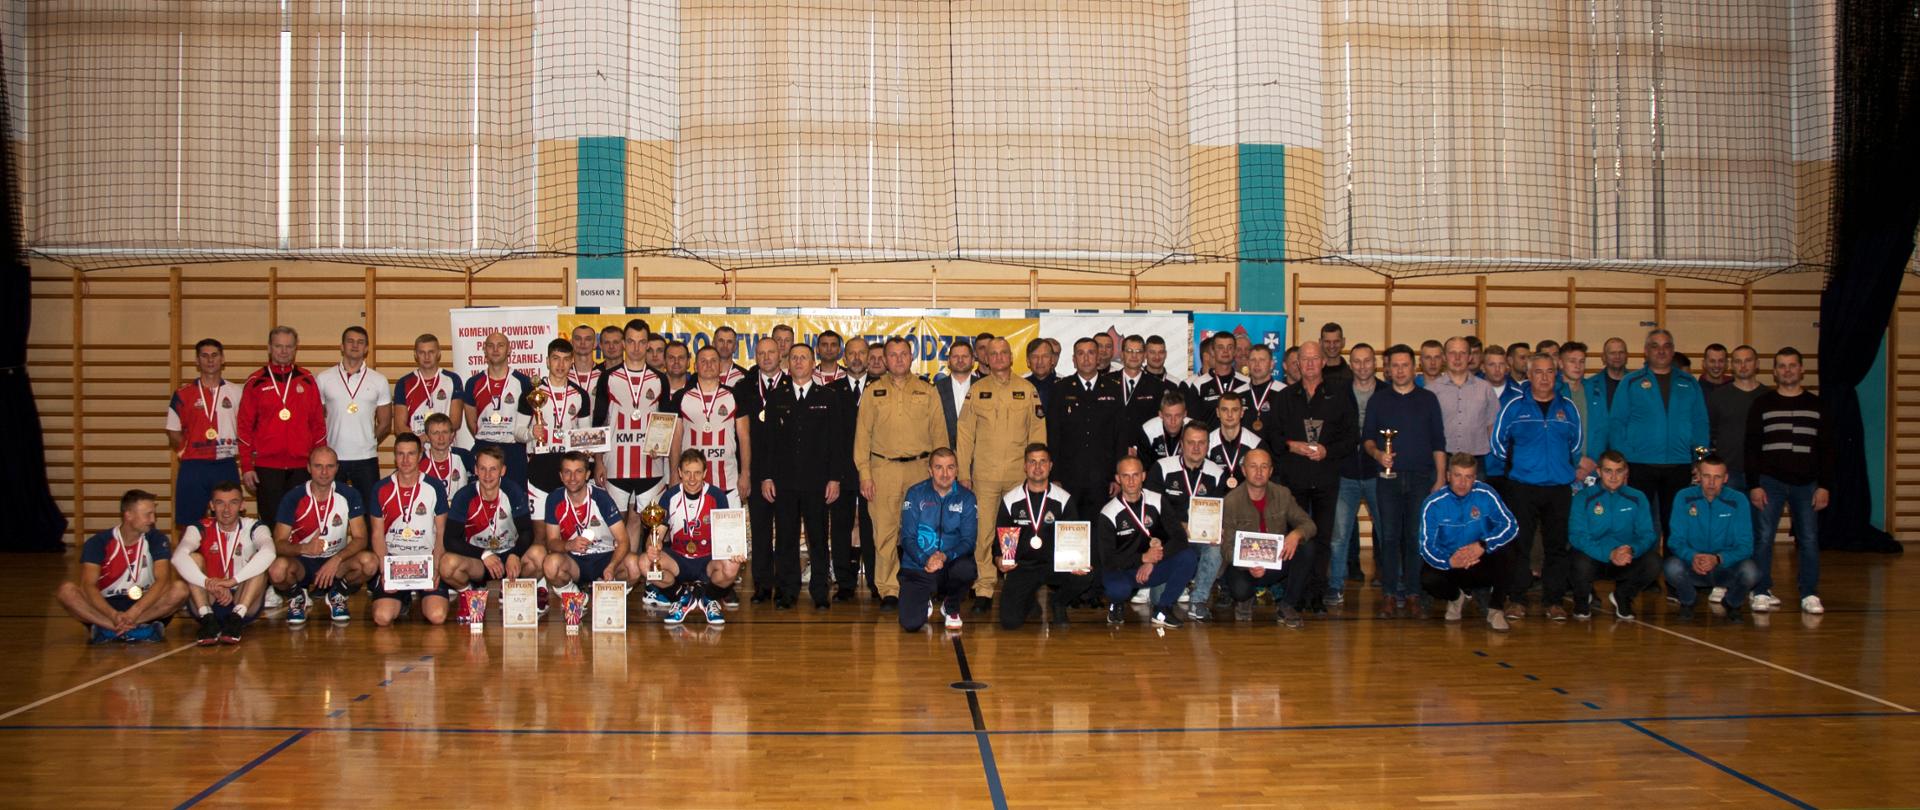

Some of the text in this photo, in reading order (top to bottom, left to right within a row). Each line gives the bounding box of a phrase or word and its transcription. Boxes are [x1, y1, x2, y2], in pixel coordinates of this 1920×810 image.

[580, 289, 605, 297] BOISKO
[459, 326, 499, 337] KOMENDA
[616, 433, 633, 443] KM
[707, 449, 726, 458] PSP
